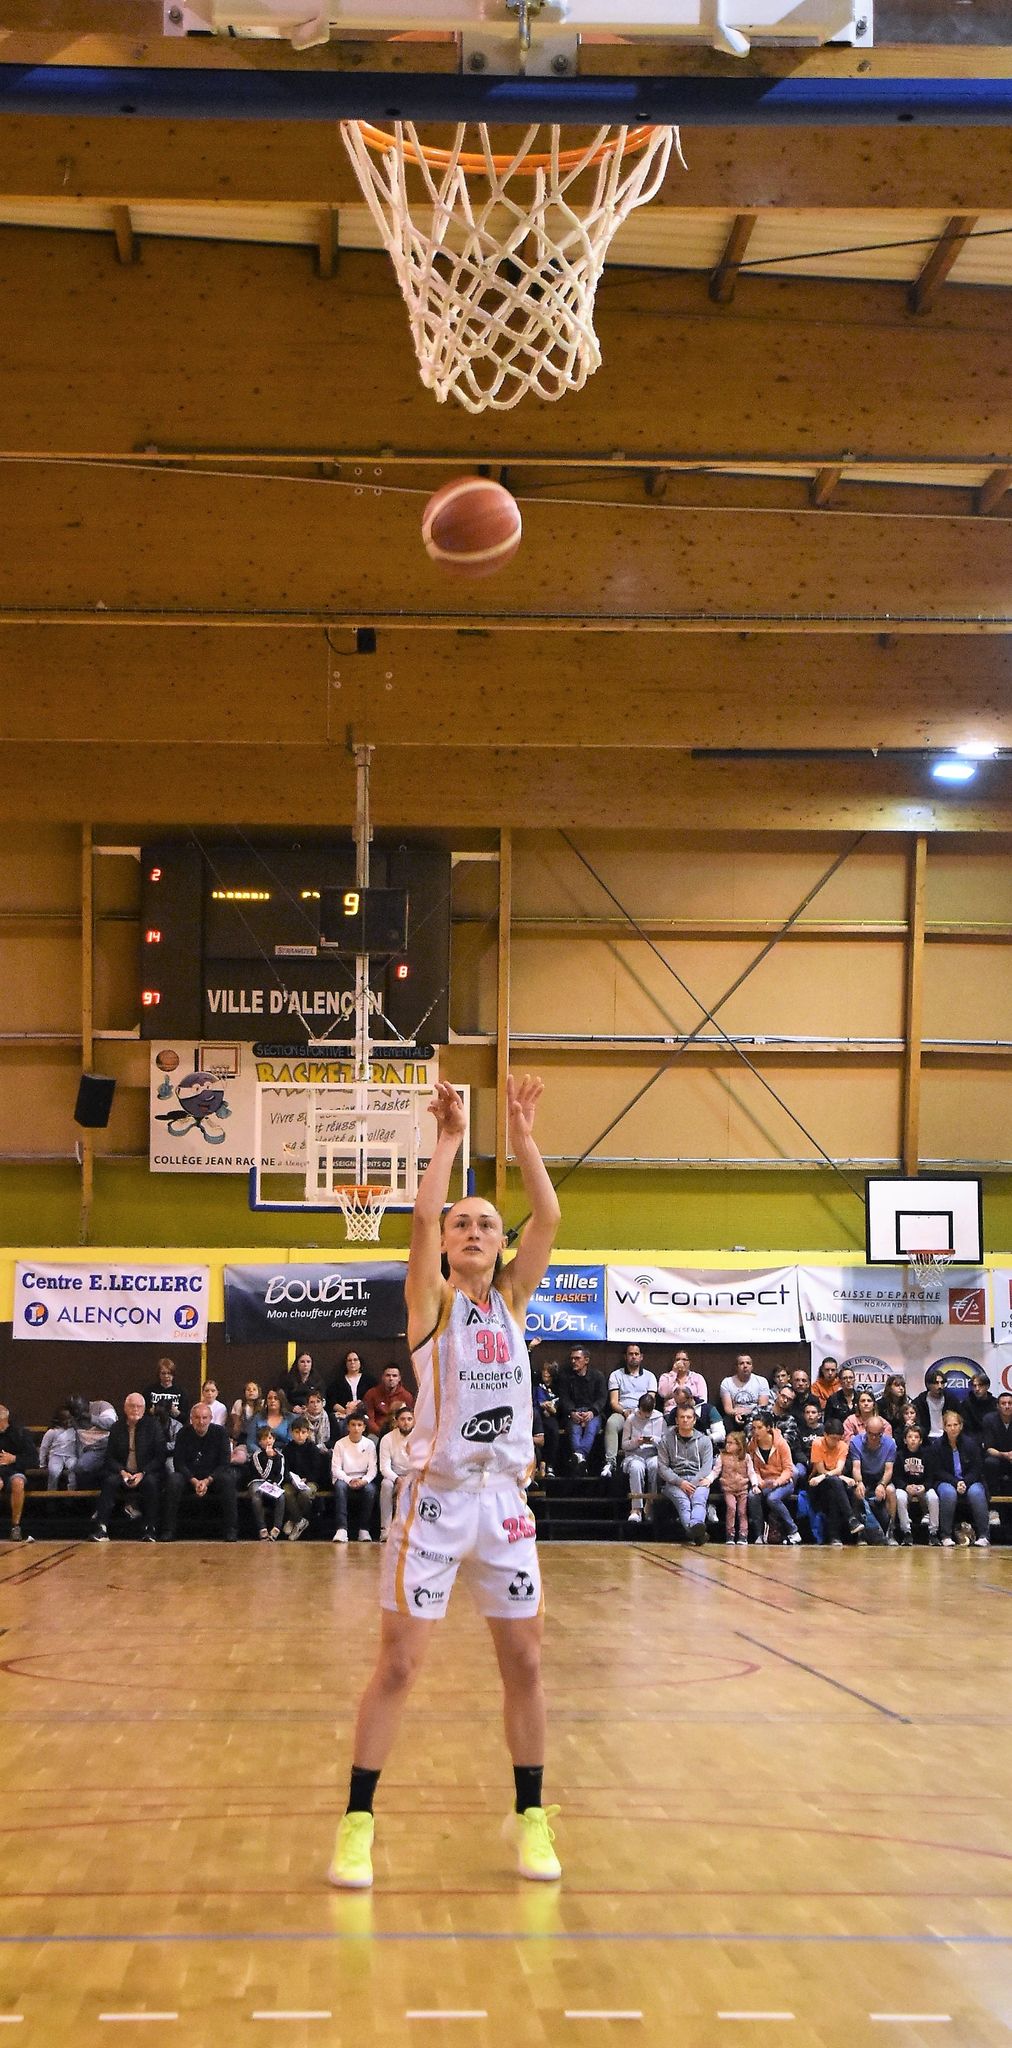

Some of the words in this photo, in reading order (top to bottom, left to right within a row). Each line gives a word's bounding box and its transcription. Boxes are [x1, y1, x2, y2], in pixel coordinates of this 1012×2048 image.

[151, 868, 161, 881] 2
[344, 892, 360, 916] 9
[146, 931, 161, 942] 14
[397, 965, 408, 978] 8
[142, 991, 161, 1005] 97
[207, 989, 264, 1014] VILLE
[270, 989, 382, 1021] D'ALENÇN
[372, 1099, 409, 1111] Basket
[270, 1112, 295, 1124] Vivre
[154, 1155, 202, 1165] COLLÈGE
[205, 1156, 232, 1166] JEAN
[235, 1157, 276, 1166] RACNE
[22, 1272, 83, 1291] Centre
[89, 1274, 203, 1292] E.LECLERC
[555, 1273, 599, 1289] filles
[536, 1293, 555, 1302] leur
[556, 1294, 593, 1302] BASKET
[832, 1289, 872, 1300] CAISSE
[876, 1291, 941, 1301] D'EPARGNE
[57, 1306, 161, 1327] ALENÇON
[267, 1309, 288, 1319] Mon
[290, 1307, 333, 1319] chauffeur
[334, 1306, 368, 1318] préféré
[805, 1312, 816, 1322] LA
[817, 1313, 850, 1324] BANQUE.
[853, 1313, 894, 1325] NOUVELLE
[897, 1312, 945, 1326] DÉFINITION.
[331, 1320, 352, 1328] depuis
[353, 1319, 368, 1328] 1976
[459, 1370, 514, 1382] E.Leclerc
[469, 1381, 508, 1394] ALENÇON
